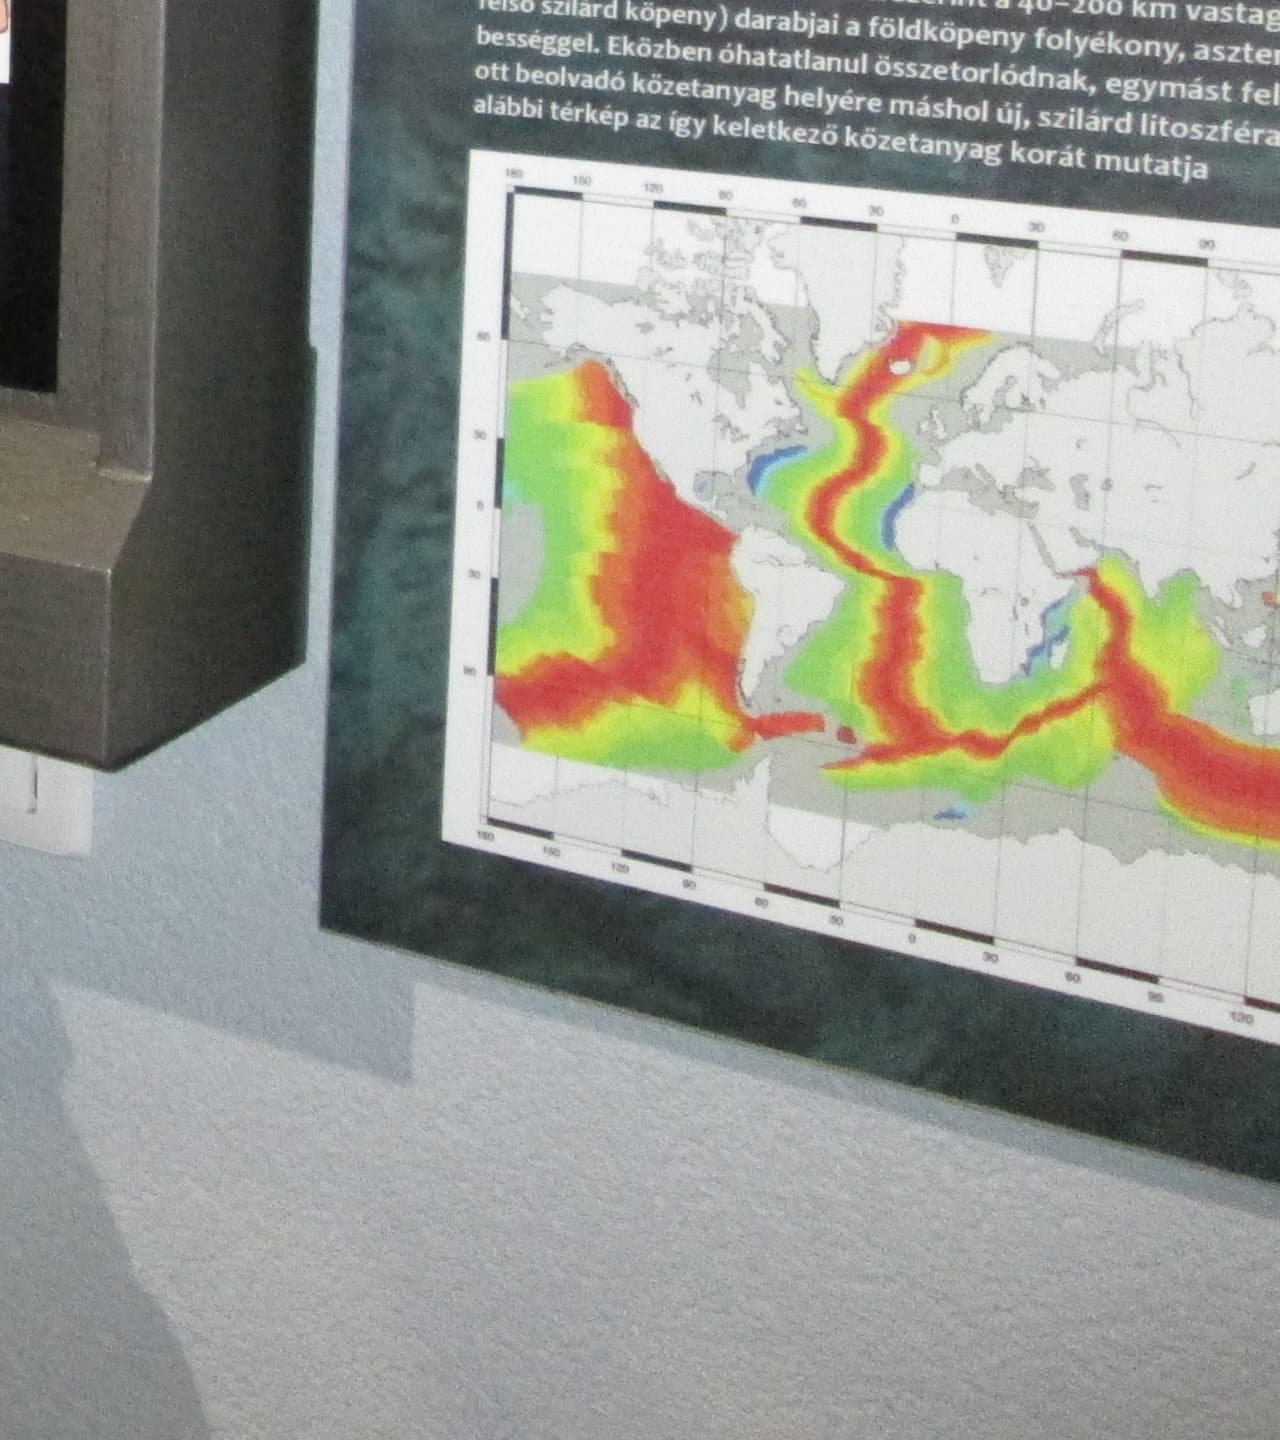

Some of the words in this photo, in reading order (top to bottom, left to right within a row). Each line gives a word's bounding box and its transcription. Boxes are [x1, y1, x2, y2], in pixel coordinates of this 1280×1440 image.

[627, 0, 728, 33] köpeny)
[734, 8, 839, 39] darabjai
[846, 21, 860, 36] a
[869, 16, 1025, 53] földköpeny
[1035, 27, 1186, 64] folyékony,
[1186, 2, 1280, 32] vastag
[476, 24, 600, 57] bességgel.
[719, 43, 868, 75] óhatatlanul
[875, 55, 1096, 96] összetorlódnak,
[1105, 76, 1232, 103] egymást
[474, 94, 543, 119] alábbi
[550, 101, 628, 131] térkép
[636, 113, 661, 130] az
[669, 111, 705, 139] így
[713, 114, 838, 146] keletkező
[1011, 140, 1087, 168] korát
[1095, 153, 1209, 184] mutatja
[475, 62, 508, 82] ott
[516, 63, 625, 91] beolvadó
[784, 85, 882, 115] helyére
[889, 96, 989, 122] máshol
[997, 102, 1030, 131] új,
[1037, 106, 1132, 134] szilárd
[1140, 112, 1280, 147] litoszféra
